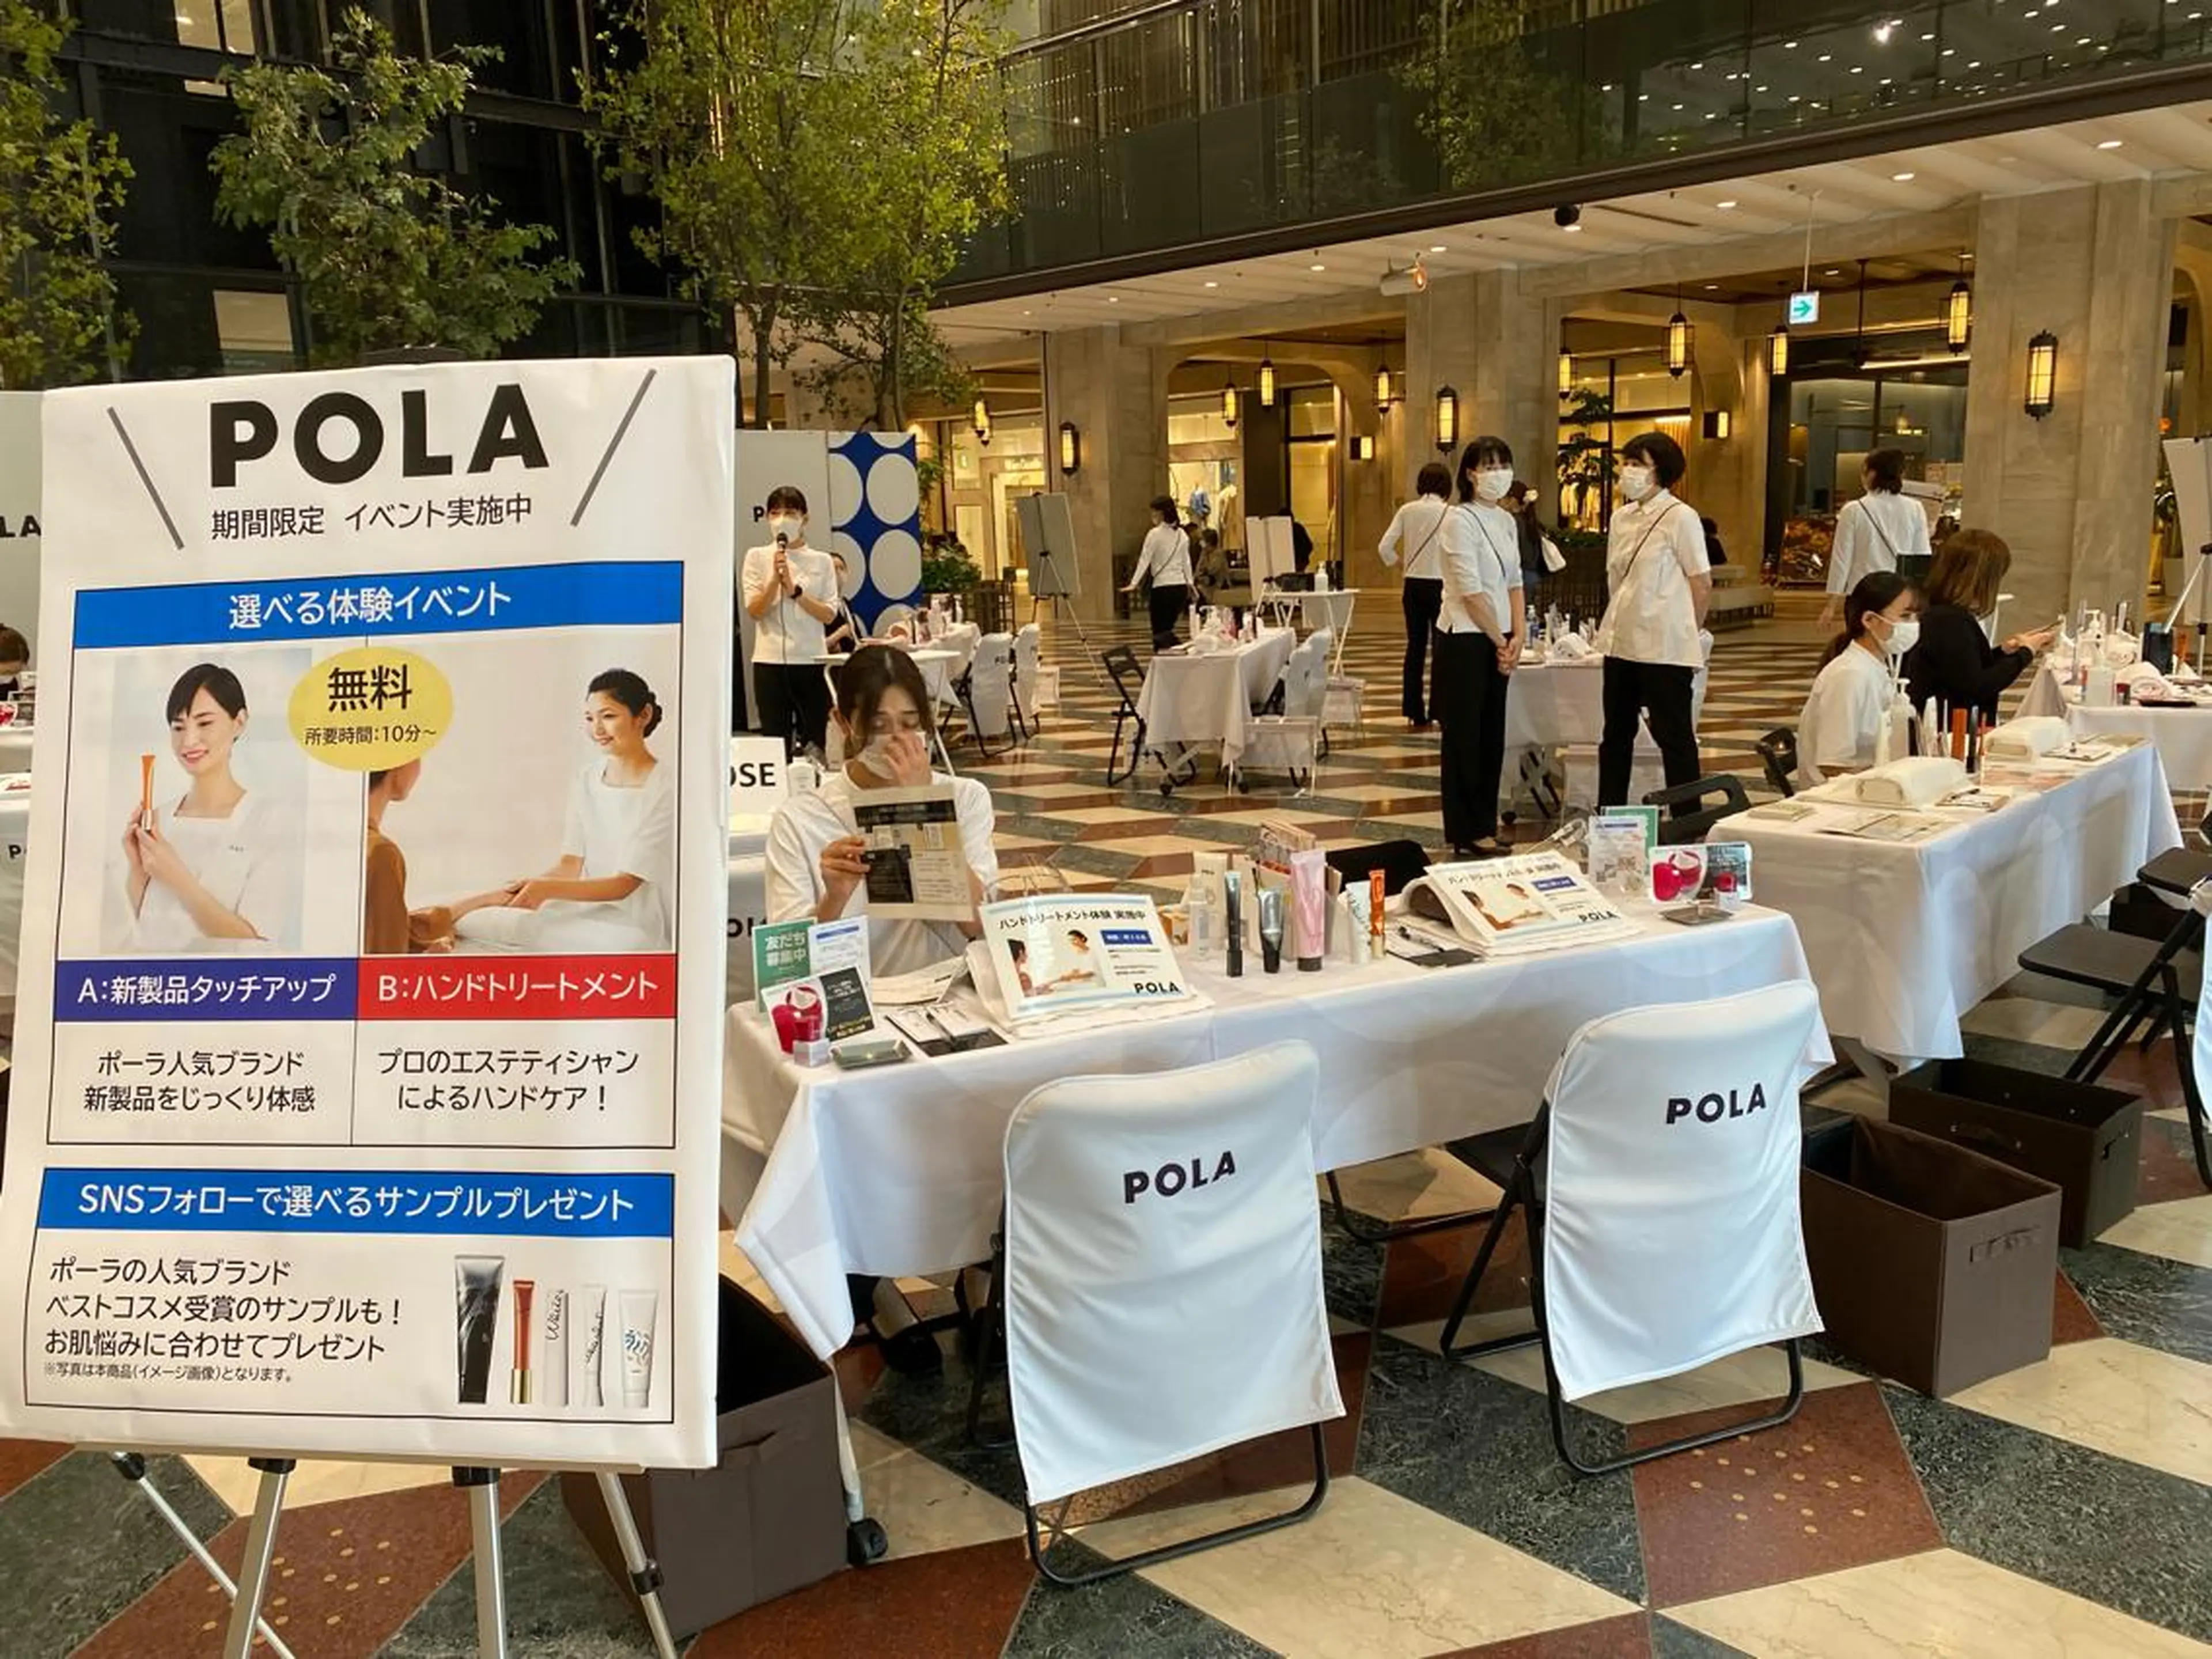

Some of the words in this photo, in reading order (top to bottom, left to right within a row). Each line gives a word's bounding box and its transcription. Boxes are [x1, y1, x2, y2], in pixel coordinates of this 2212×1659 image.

[210, 384, 550, 488] POLA
[211, 507, 325, 540] 期間限定
[344, 493, 532, 531] イベント実施中
[229, 582, 512, 631] 選べる体験イベント
[328, 664, 412, 712] 無料
[730, 763, 776, 787] SE
[78, 975, 336, 1003] A：新製品タッチアップ
[378, 971, 659, 1001] B：ハンドトリートメント
[1134, 981, 1183, 994] POLA
[98, 1051, 305, 1077] ポーラ人気ブランド
[378, 1048, 639, 1075] プロのエステティシャン
[84, 1086, 316, 1113] 新製品をじっくり体感
[397, 1085, 607, 1111] によるハンドケア！
[1666, 1082, 1766, 1124] POLA
[1123, 1150, 1236, 1204] POLA
[79, 1184, 634, 1221] SNSフォローで選べるサンプルプレゼント
[50, 1256, 291, 1284] ポーラの人気ブランド
[46, 1295, 402, 1325] ベストコスメ受賞のサンプルも！
[46, 1330, 385, 1361] お肌悩みに合わせてプレゼント
